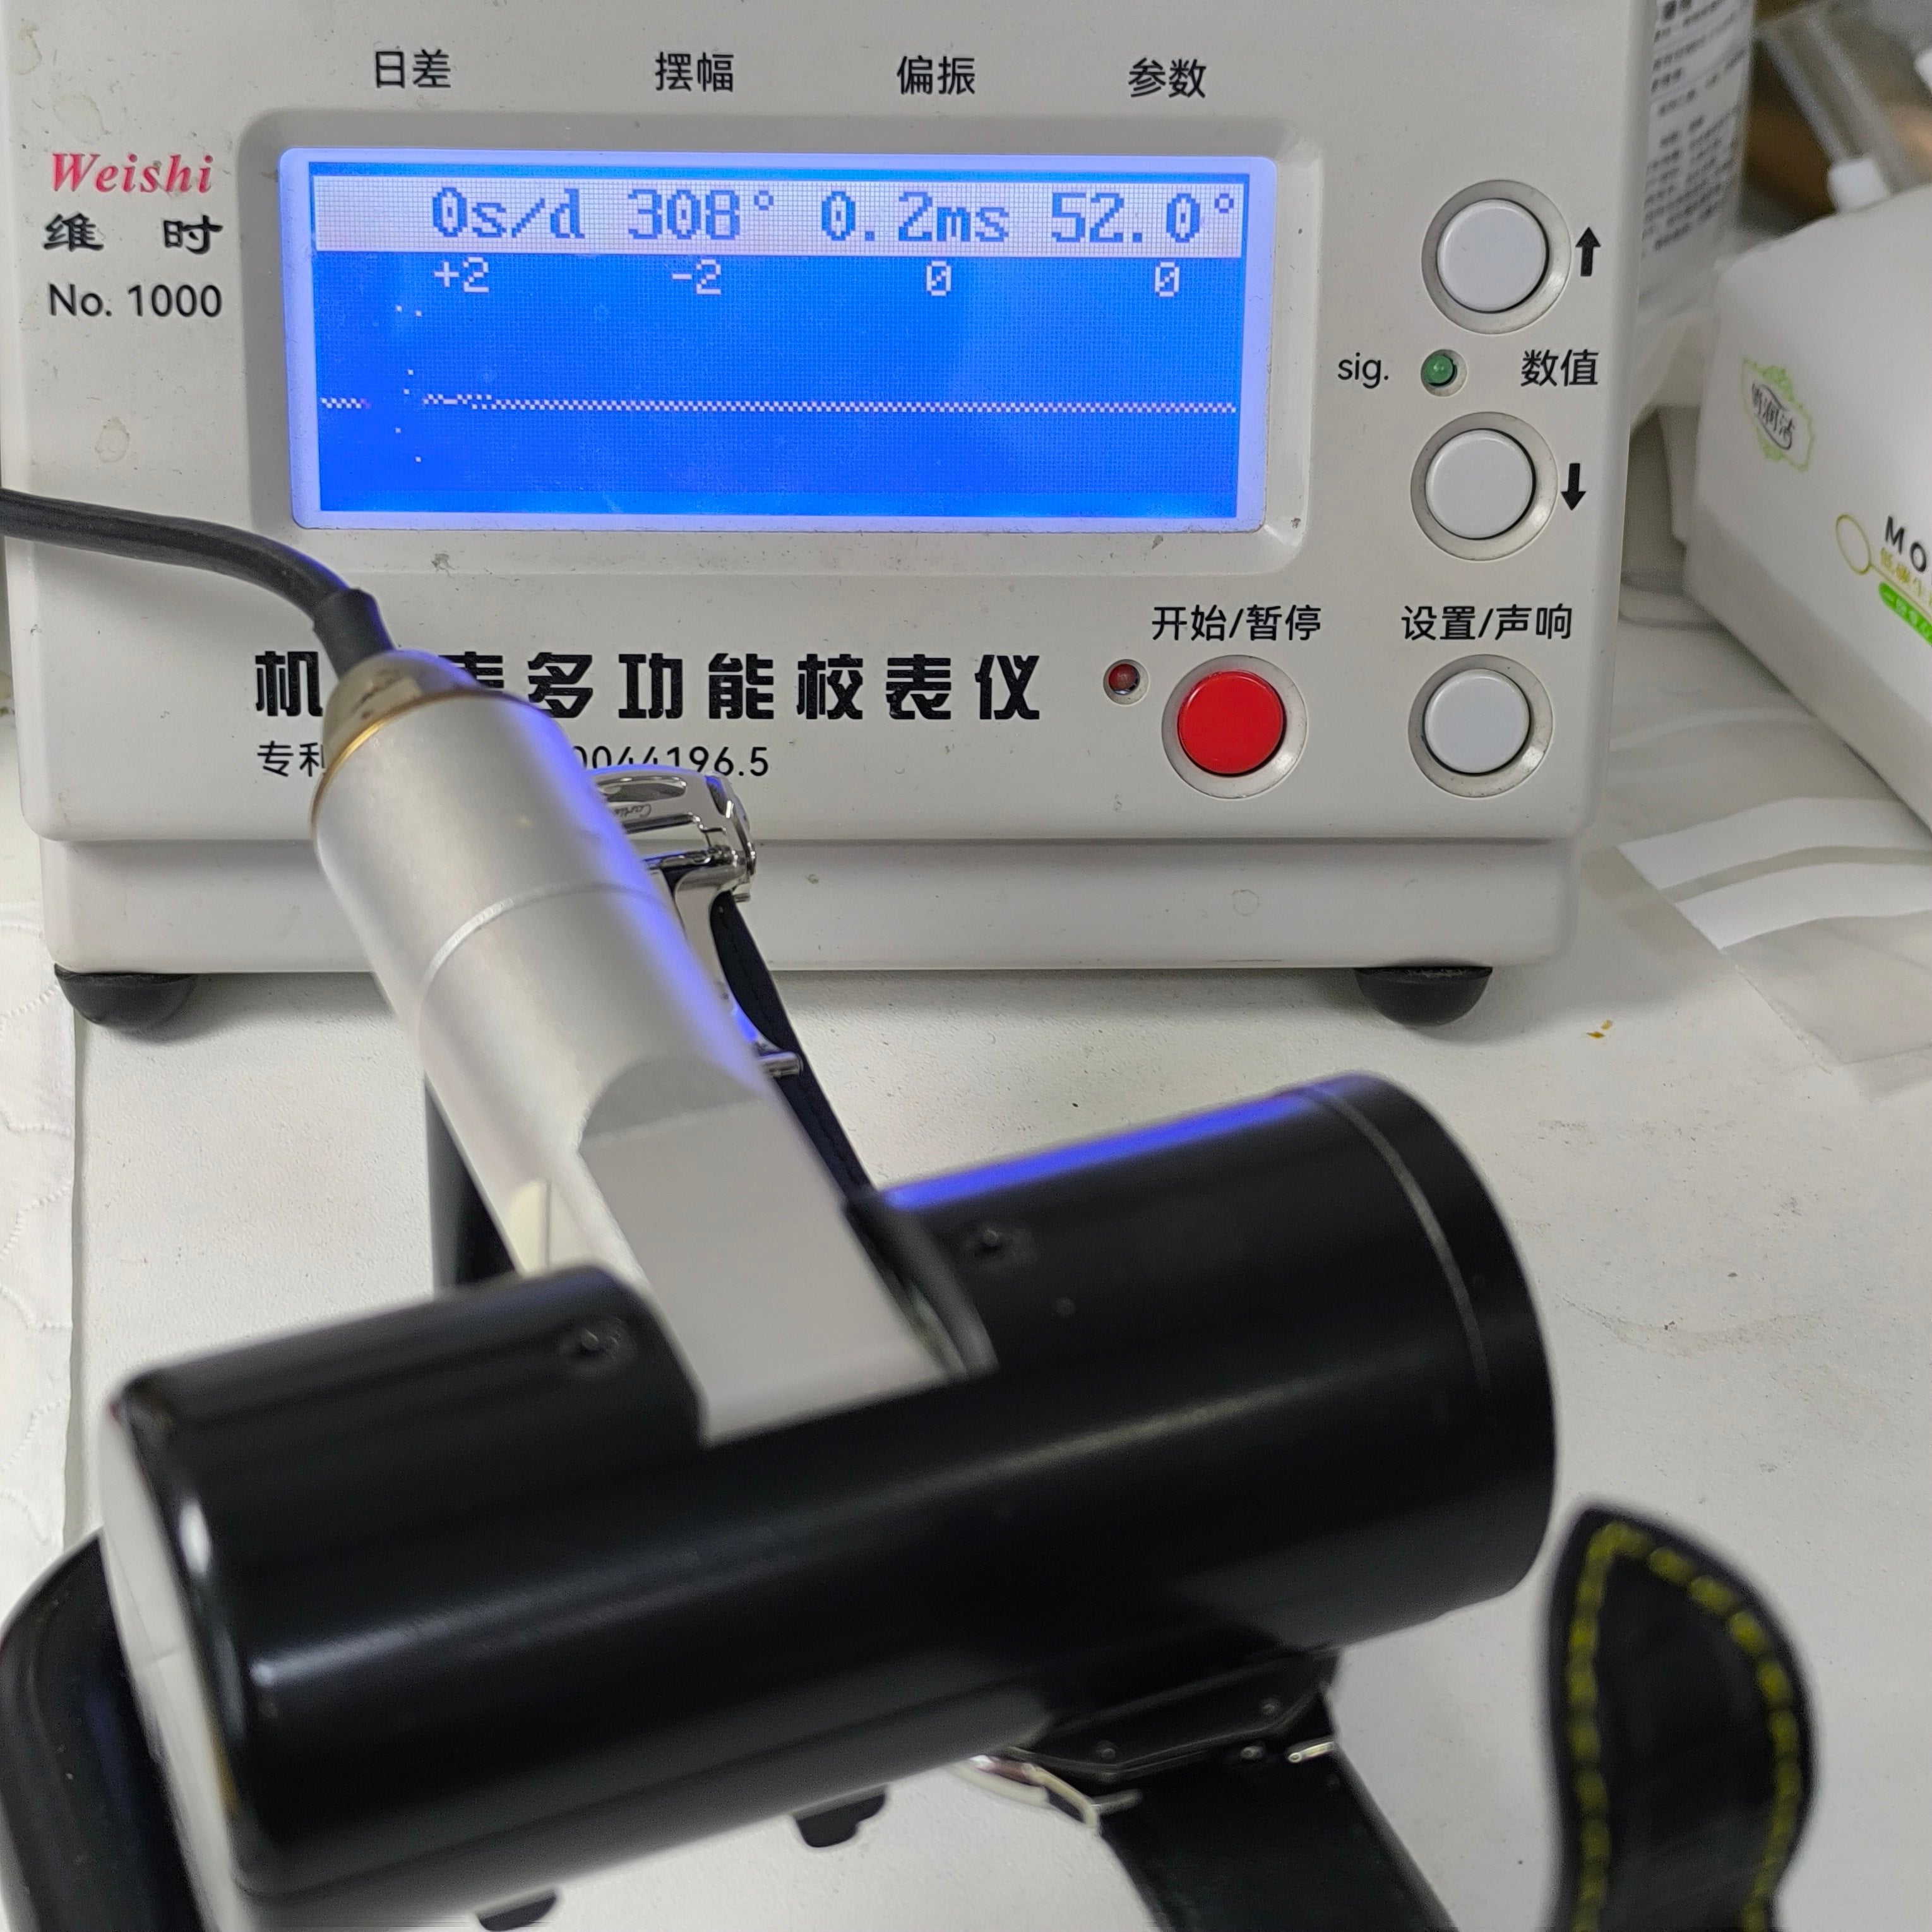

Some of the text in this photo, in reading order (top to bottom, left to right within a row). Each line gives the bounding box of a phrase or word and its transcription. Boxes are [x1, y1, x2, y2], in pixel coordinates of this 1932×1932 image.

[375, 49, 451, 88] 日差
[655, 51, 734, 92] 摆幅
[897, 54, 975, 95] 偏振
[1128, 57, 1207, 98] 参数
[52, 152, 212, 193] Weishi
[44, 213, 224, 254] 维时
[432, 187, 585, 239] 0s/d
[821, 191, 1009, 242] 0.2ms
[434, 256, 489, 292] +2
[672, 259, 721, 294] -2
[49, 283, 222, 318] No. 1000
[1337, 352, 1389, 389] sig.
[1520, 349, 1599, 387] 数值
[1885, 515, 1932, 585] MO
[1152, 604, 1321, 641] 开始/暂停
[1401, 603, 1572, 641] 设置/声响
[255, 650, 1041, 720] 机多功能校表仪
